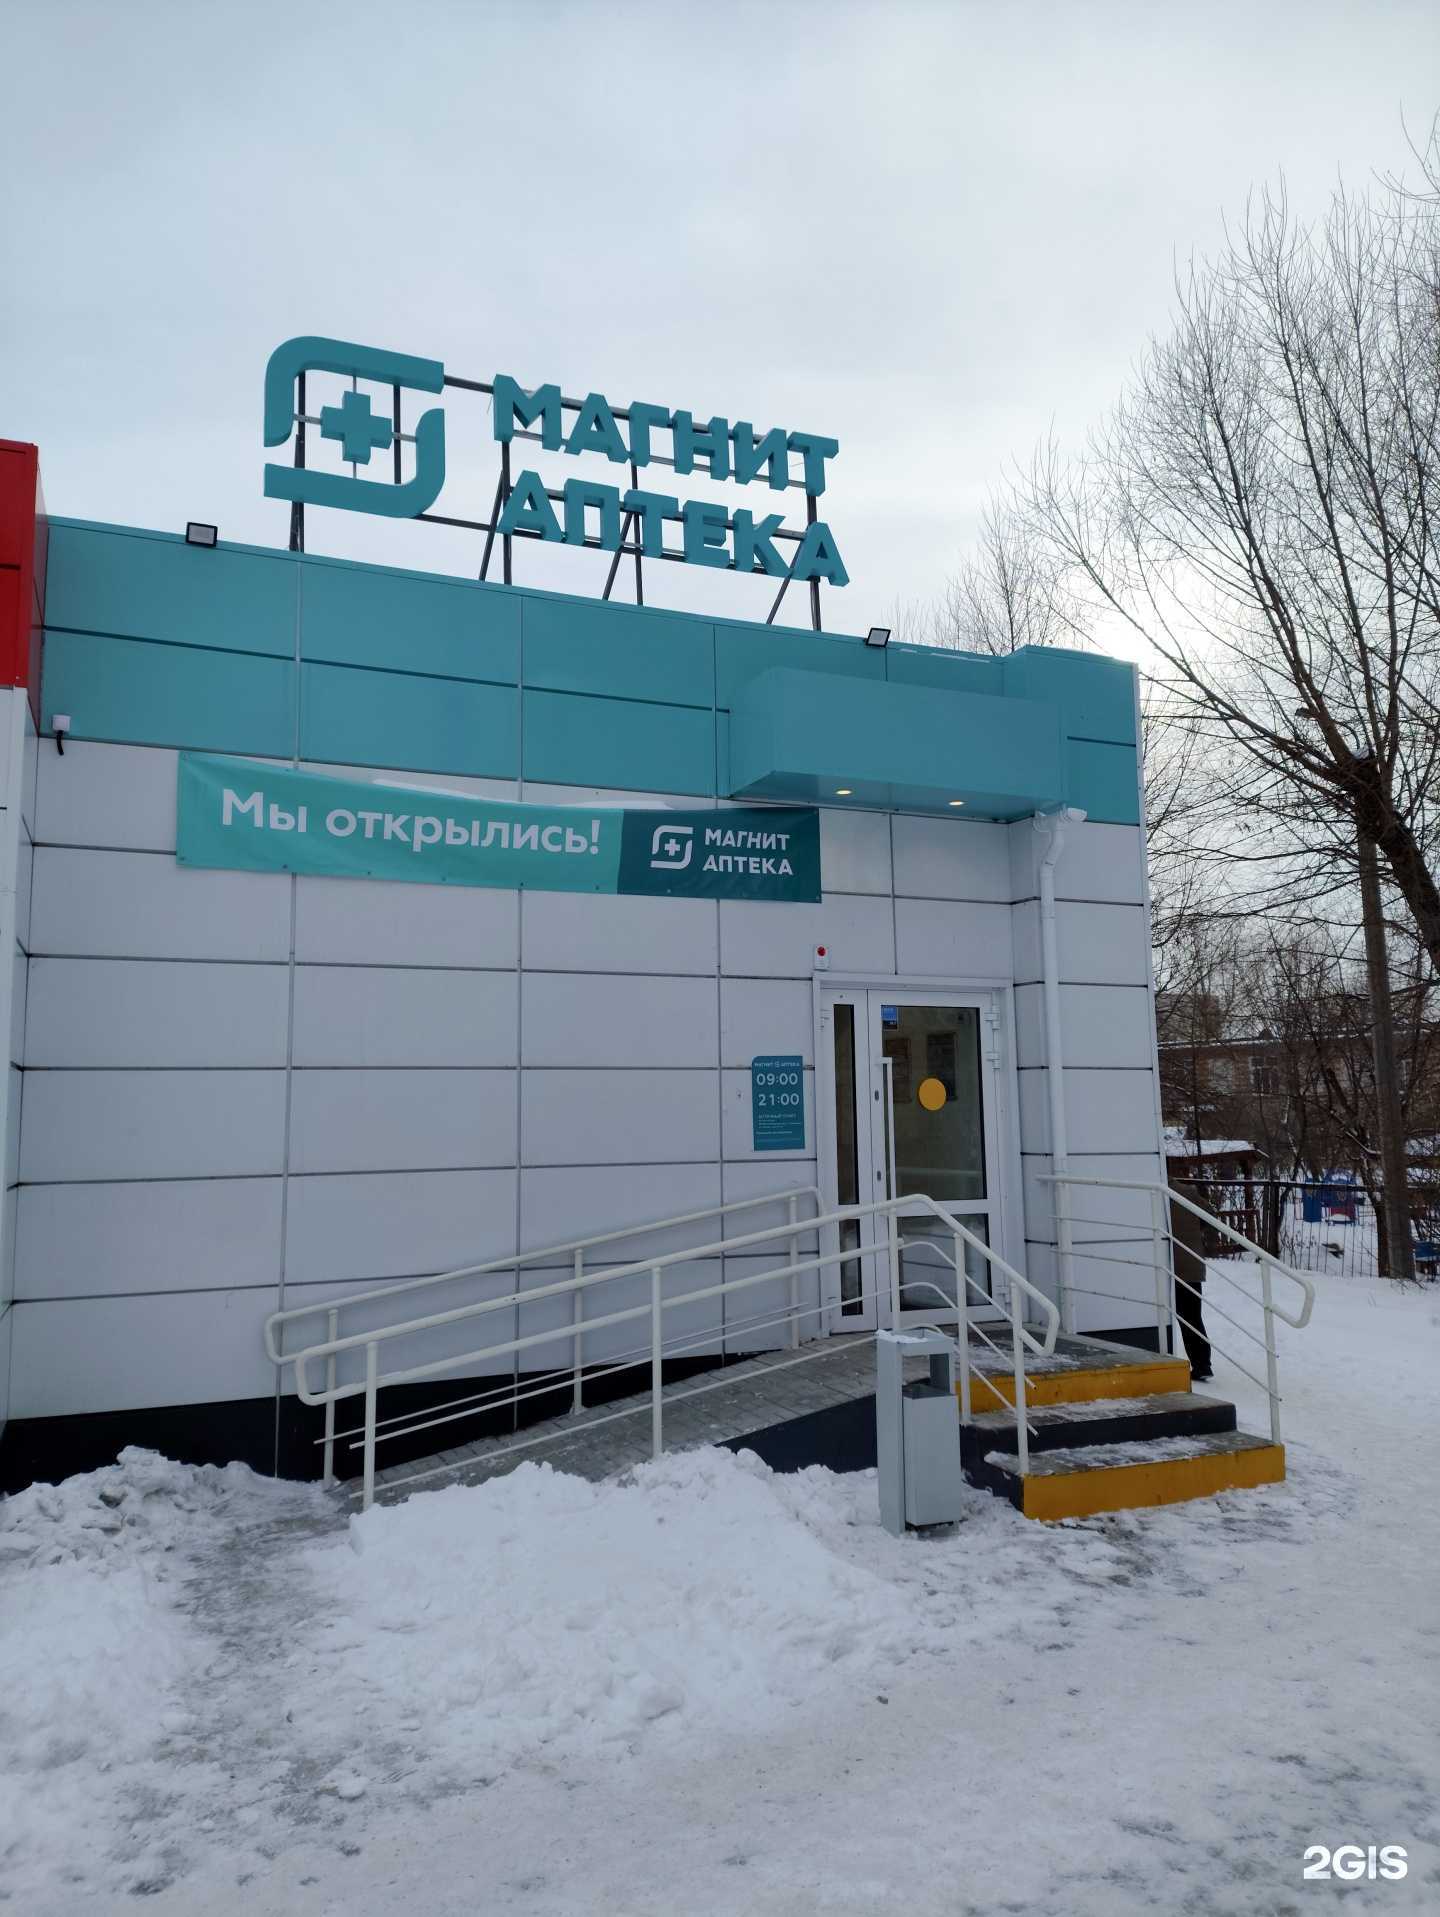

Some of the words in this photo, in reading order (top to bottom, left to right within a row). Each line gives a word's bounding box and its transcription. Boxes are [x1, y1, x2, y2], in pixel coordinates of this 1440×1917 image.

[493, 373, 839, 496] МАГНИТ
[497, 470, 850, 587] АПТЕКА
[221, 788, 307, 833] Мы
[325, 808, 601, 856] открылись!
[704, 827, 791, 853] МАГНИТ
[702, 854, 795, 877] АПТЕКА
[756, 1073, 798, 1086] 09:00
[758, 1093, 800, 1106] 21:00
